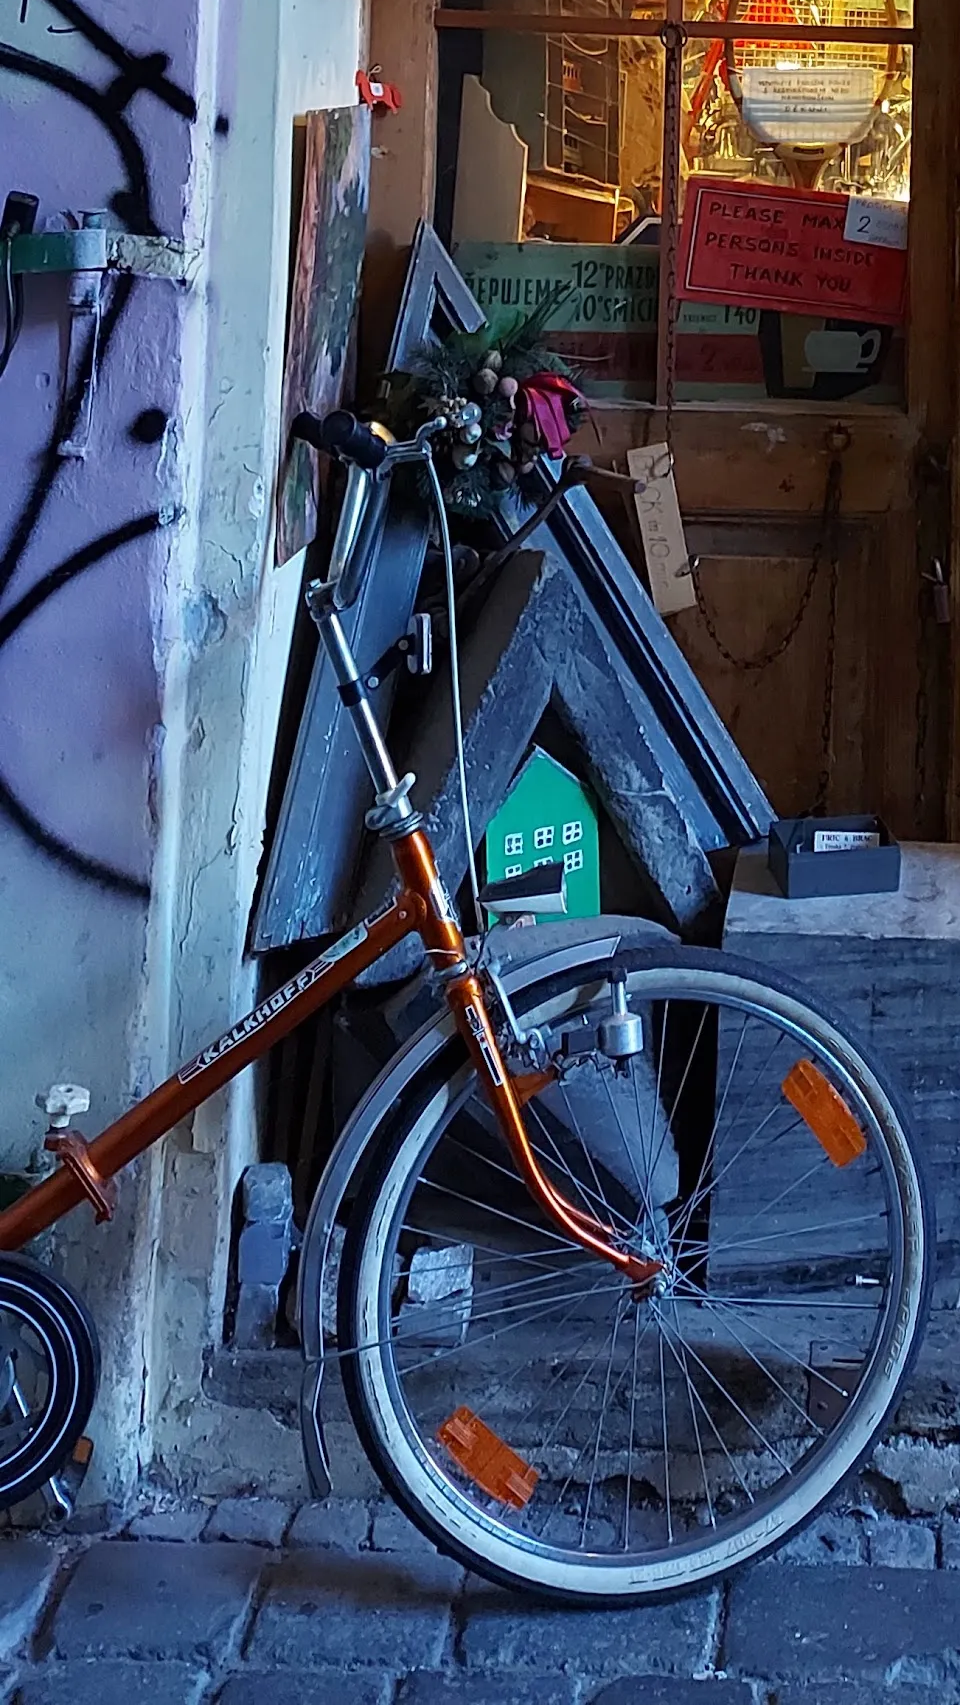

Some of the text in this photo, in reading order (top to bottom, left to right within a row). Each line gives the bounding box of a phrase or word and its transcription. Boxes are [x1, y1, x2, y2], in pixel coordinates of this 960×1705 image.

[709, 201, 784, 224] PLEASE
[857, 215, 871, 234] 2
[704, 232, 874, 266] PERSONS INSIDE
[605, 263, 658, 290] PRAZD
[730, 262, 852, 293] THANK YOU
[202, 971, 313, 1065] KALKHOFF
